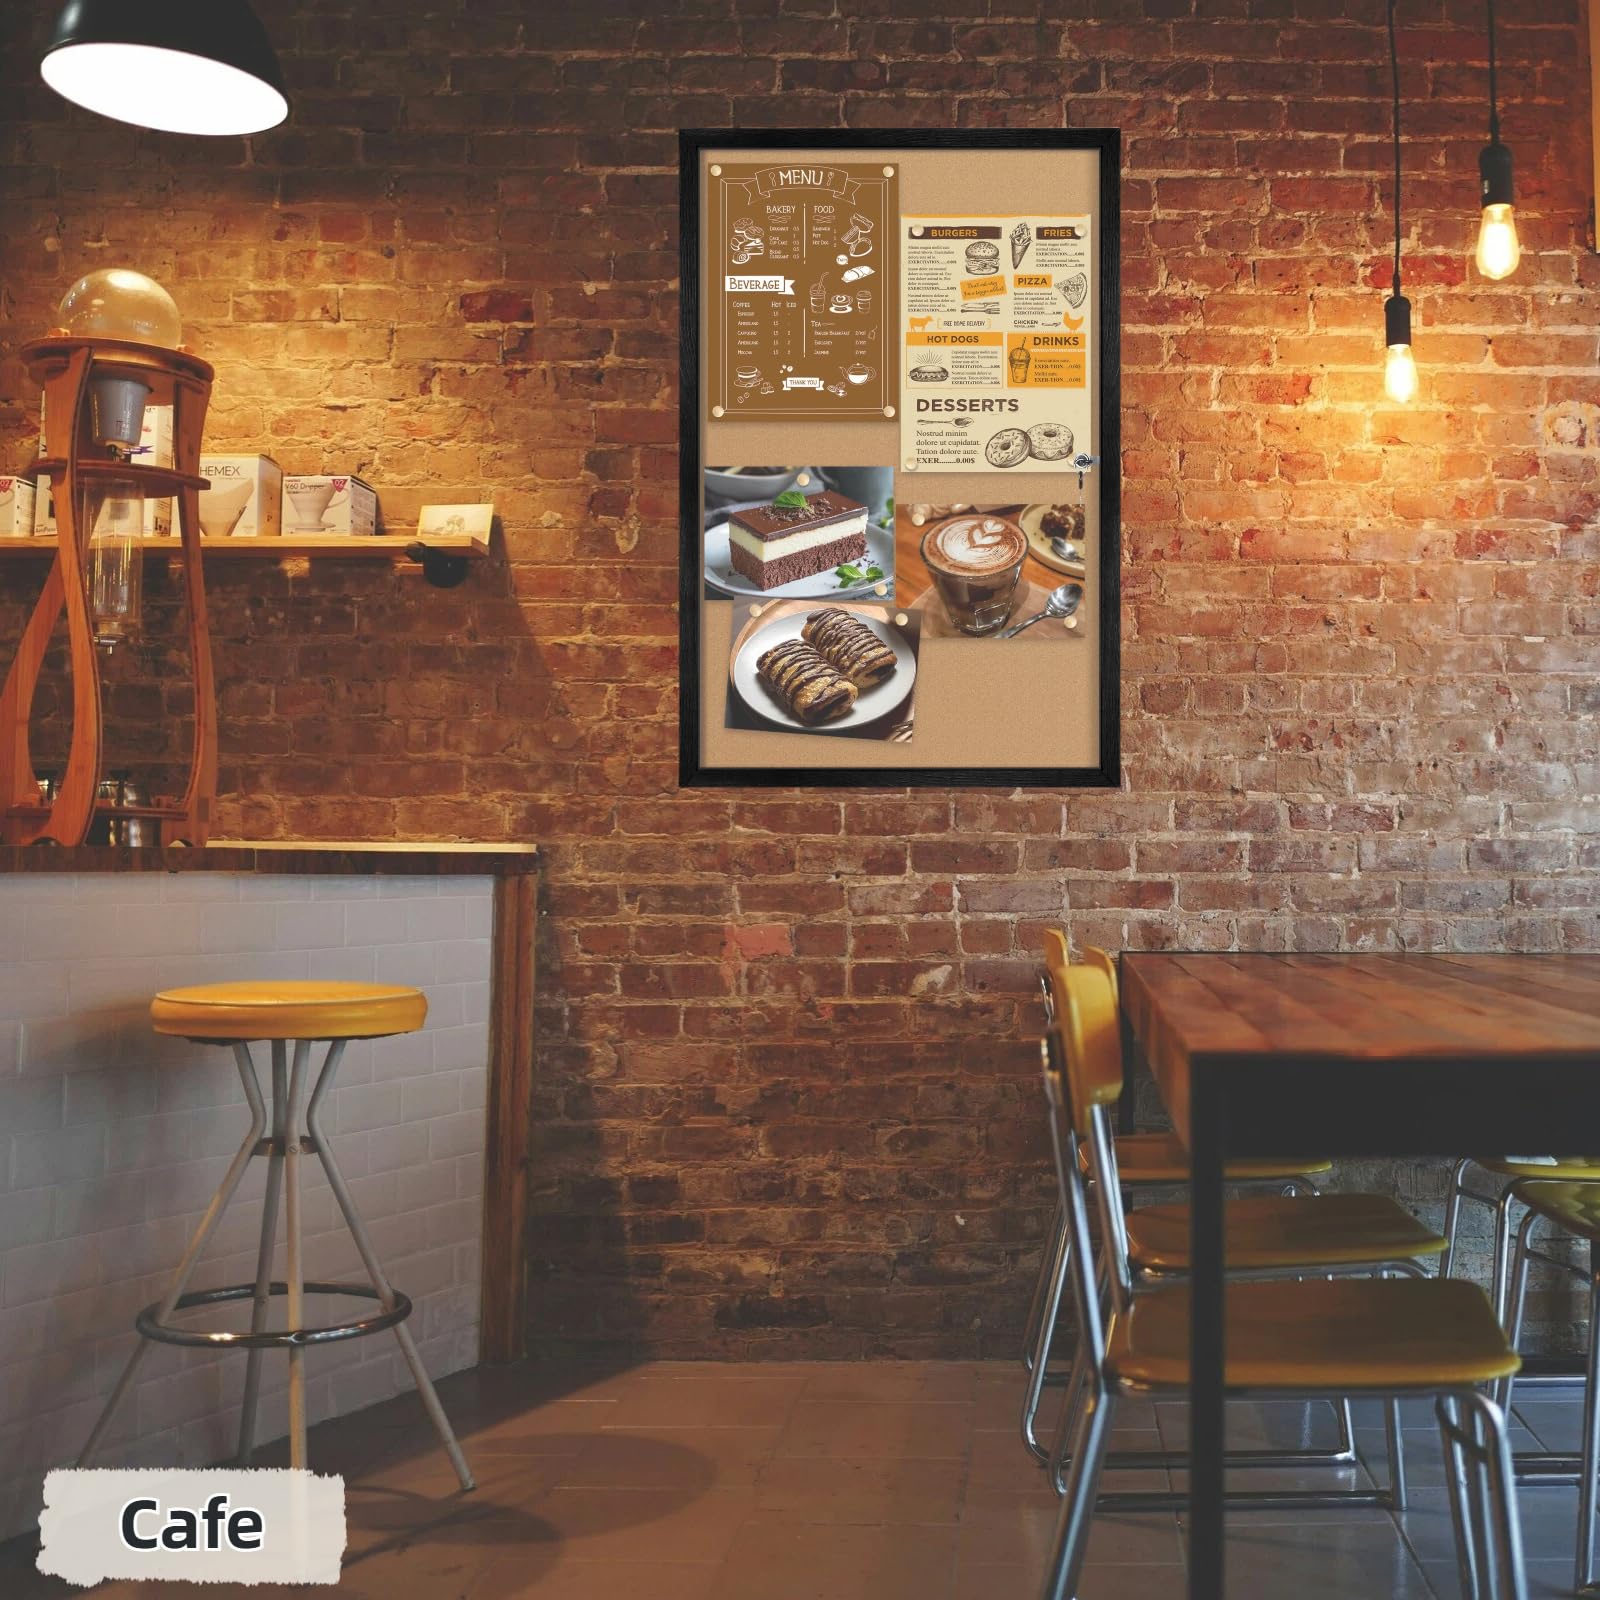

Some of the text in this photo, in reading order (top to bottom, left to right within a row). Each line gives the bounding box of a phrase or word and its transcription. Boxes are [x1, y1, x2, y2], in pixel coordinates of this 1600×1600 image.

[779, 170, 824, 186] MENU
[766, 205, 796, 214] BAKERY
[813, 205, 835, 214] FOOD
[931, 229, 978, 237] BURGERS
[1043, 229, 1072, 237] FRIES
[1018, 277, 1048, 285] PIZZA
[927, 335, 979, 343] HOT DOGS
[1033, 336, 1080, 346] DRINKS
[916, 398, 1019, 412] DESSERTS
[200, 465, 241, 476] HEMEX
[334, 480, 344, 489] 02
